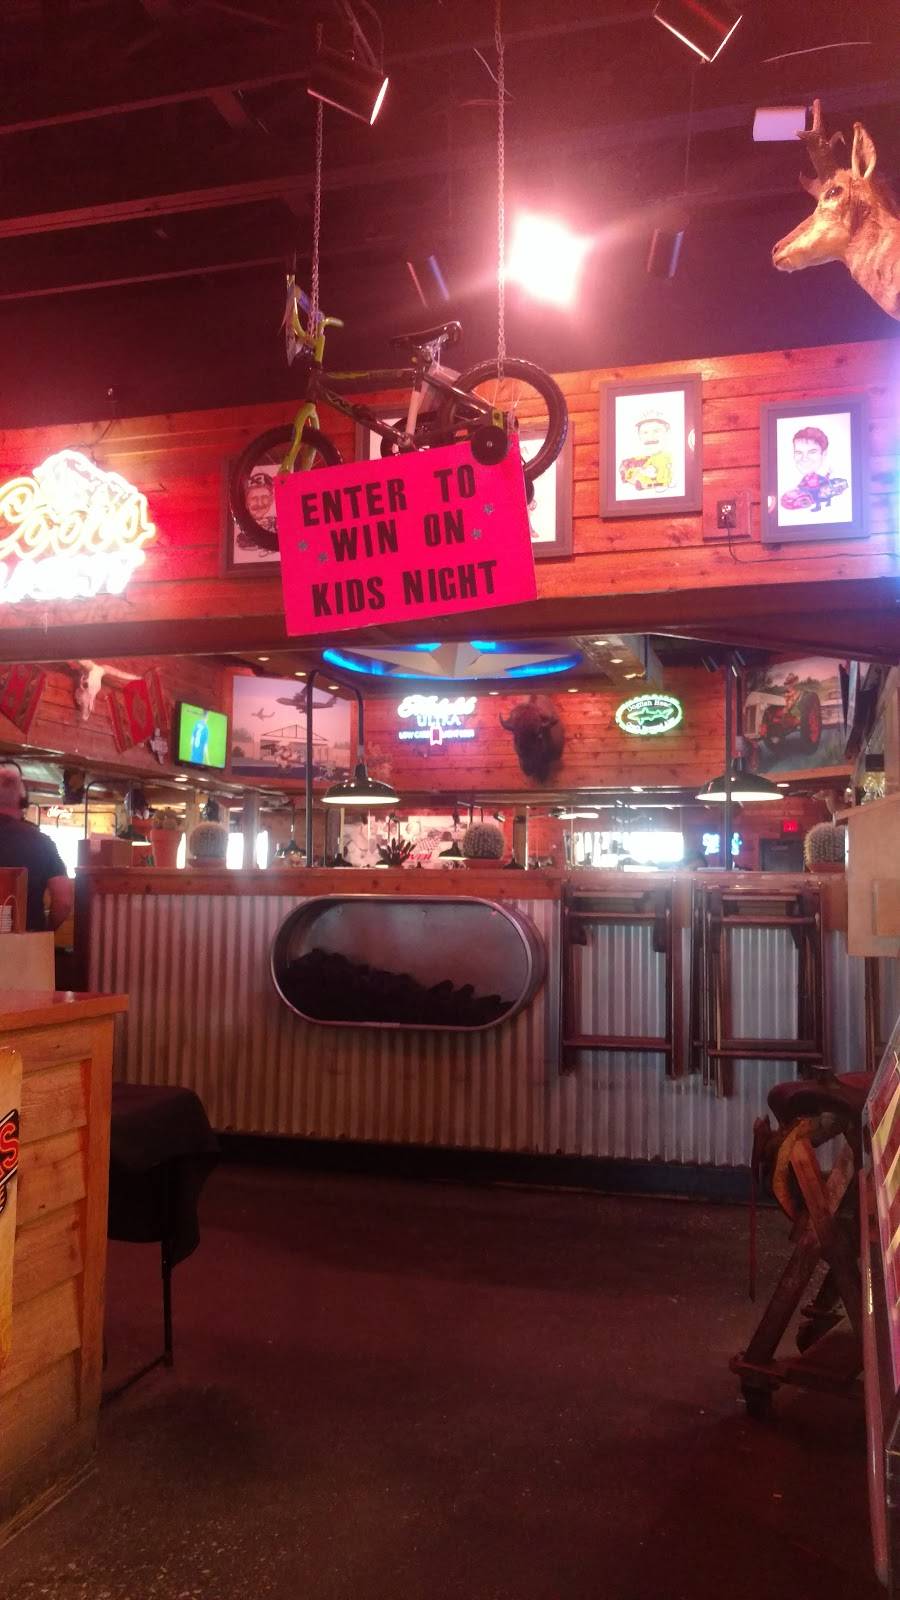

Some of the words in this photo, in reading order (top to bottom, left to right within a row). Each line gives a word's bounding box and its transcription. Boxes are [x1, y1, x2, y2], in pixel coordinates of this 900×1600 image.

[301, 478, 407, 527] ENTER
[433, 464, 477, 503] TO
[331, 519, 399, 562] WIN
[423, 509, 465, 547] ON
[311, 576, 386, 617] KIDS
[402, 560, 497, 605] NIGHT
